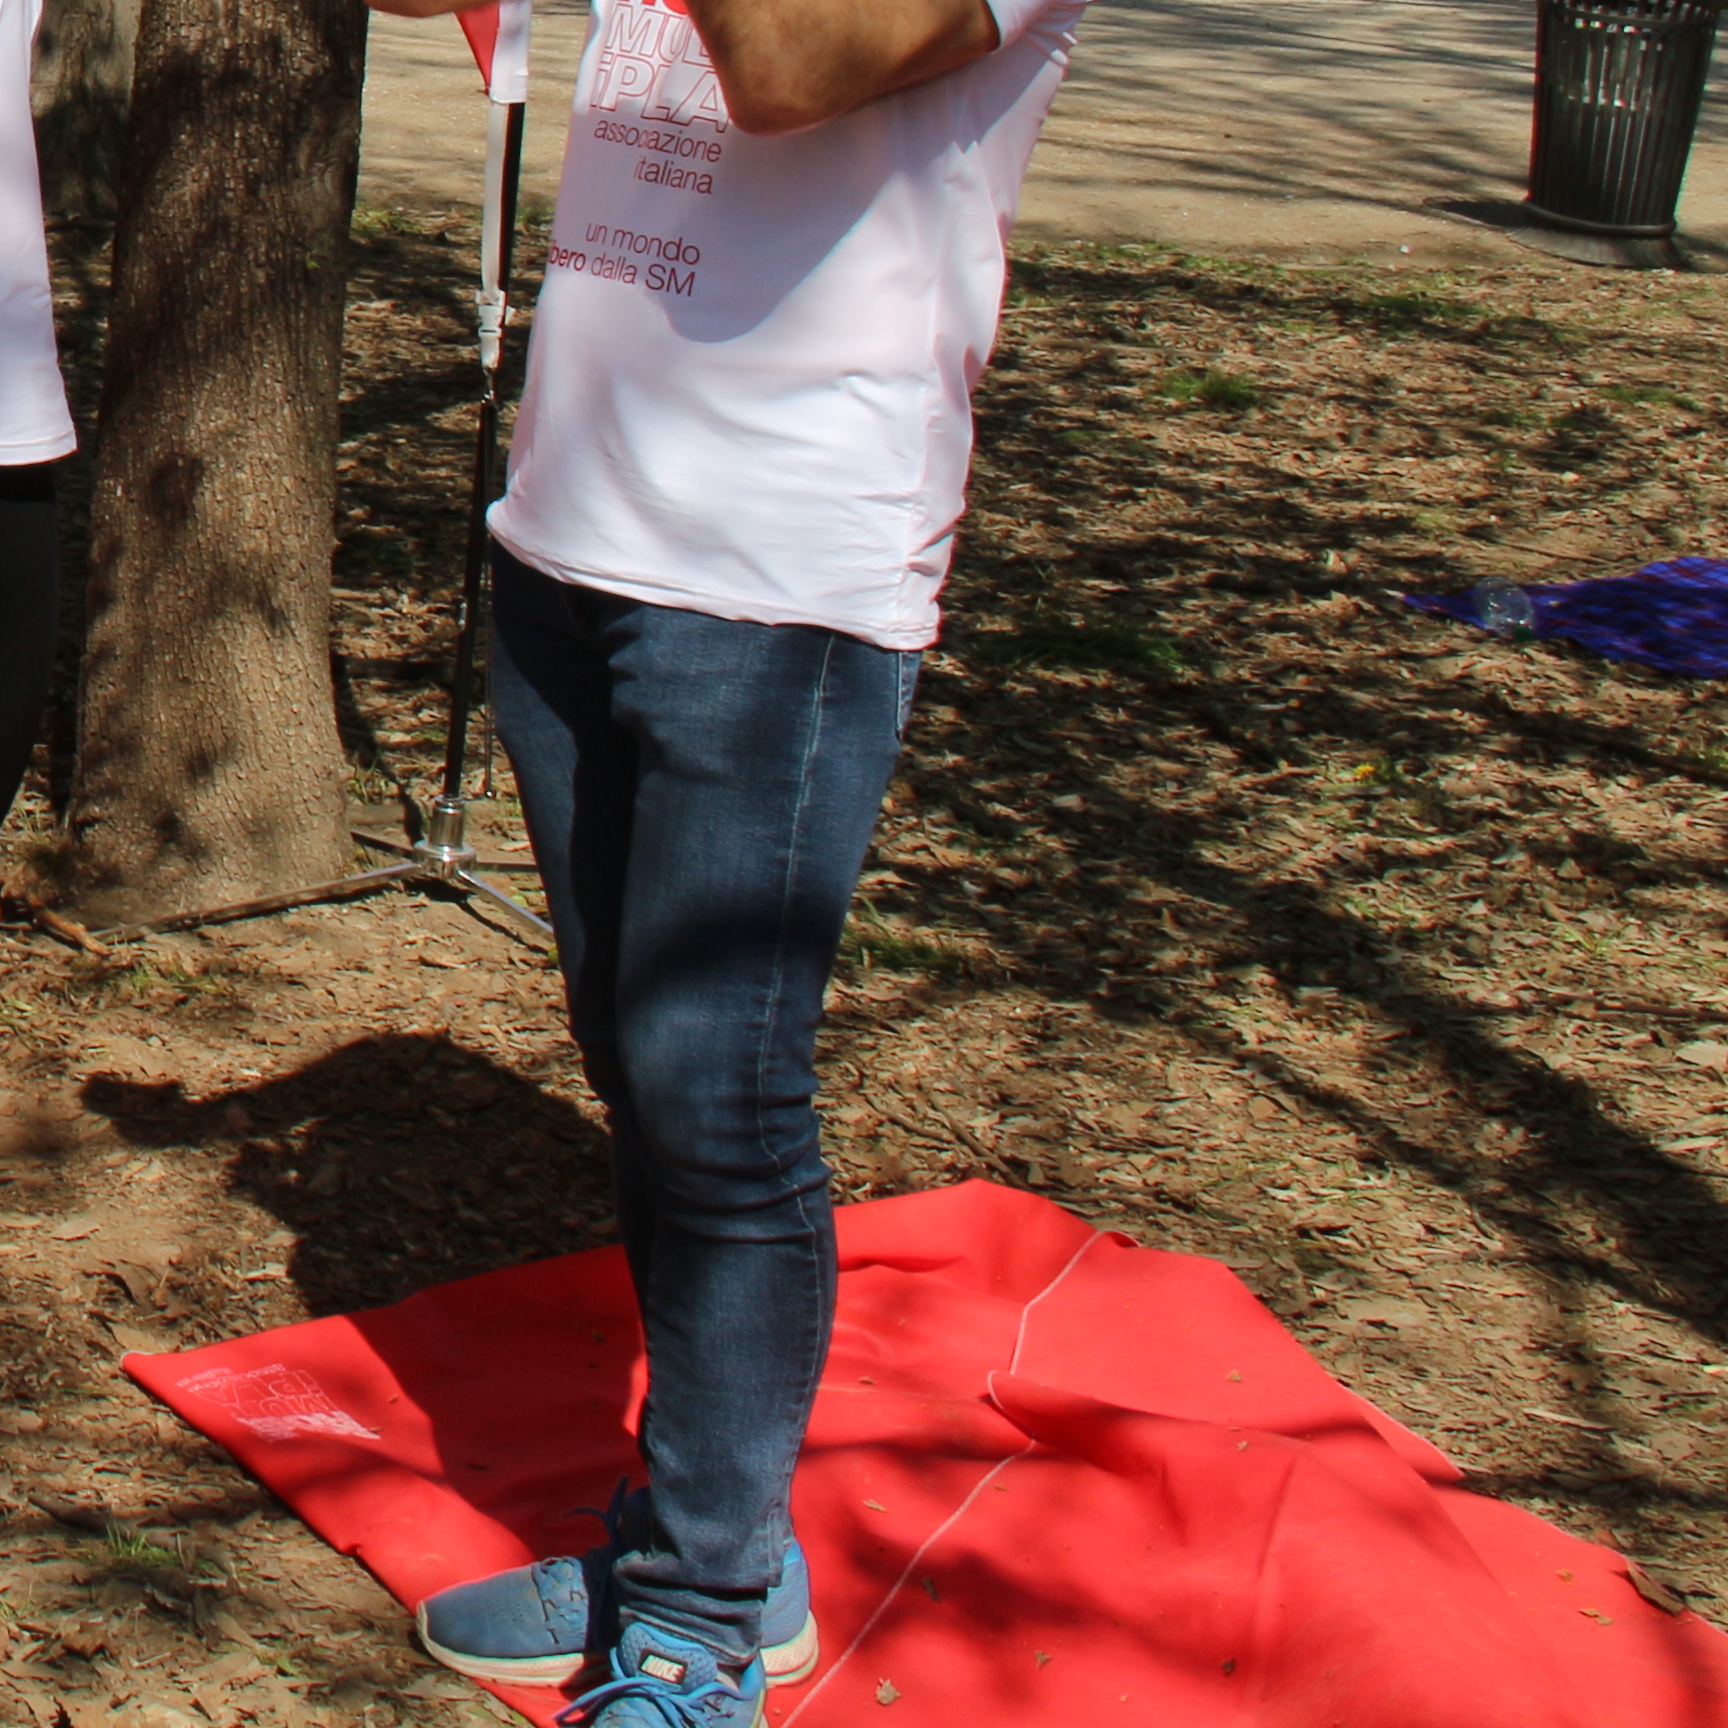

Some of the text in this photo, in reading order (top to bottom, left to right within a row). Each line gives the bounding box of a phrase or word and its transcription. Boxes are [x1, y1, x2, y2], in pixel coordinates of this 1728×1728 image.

[605, 3, 716, 68] MUL
[634, 154, 713, 195] italiana
[548, 239, 696, 297] bero dalla SM
[585, 223, 701, 265] un mondo
